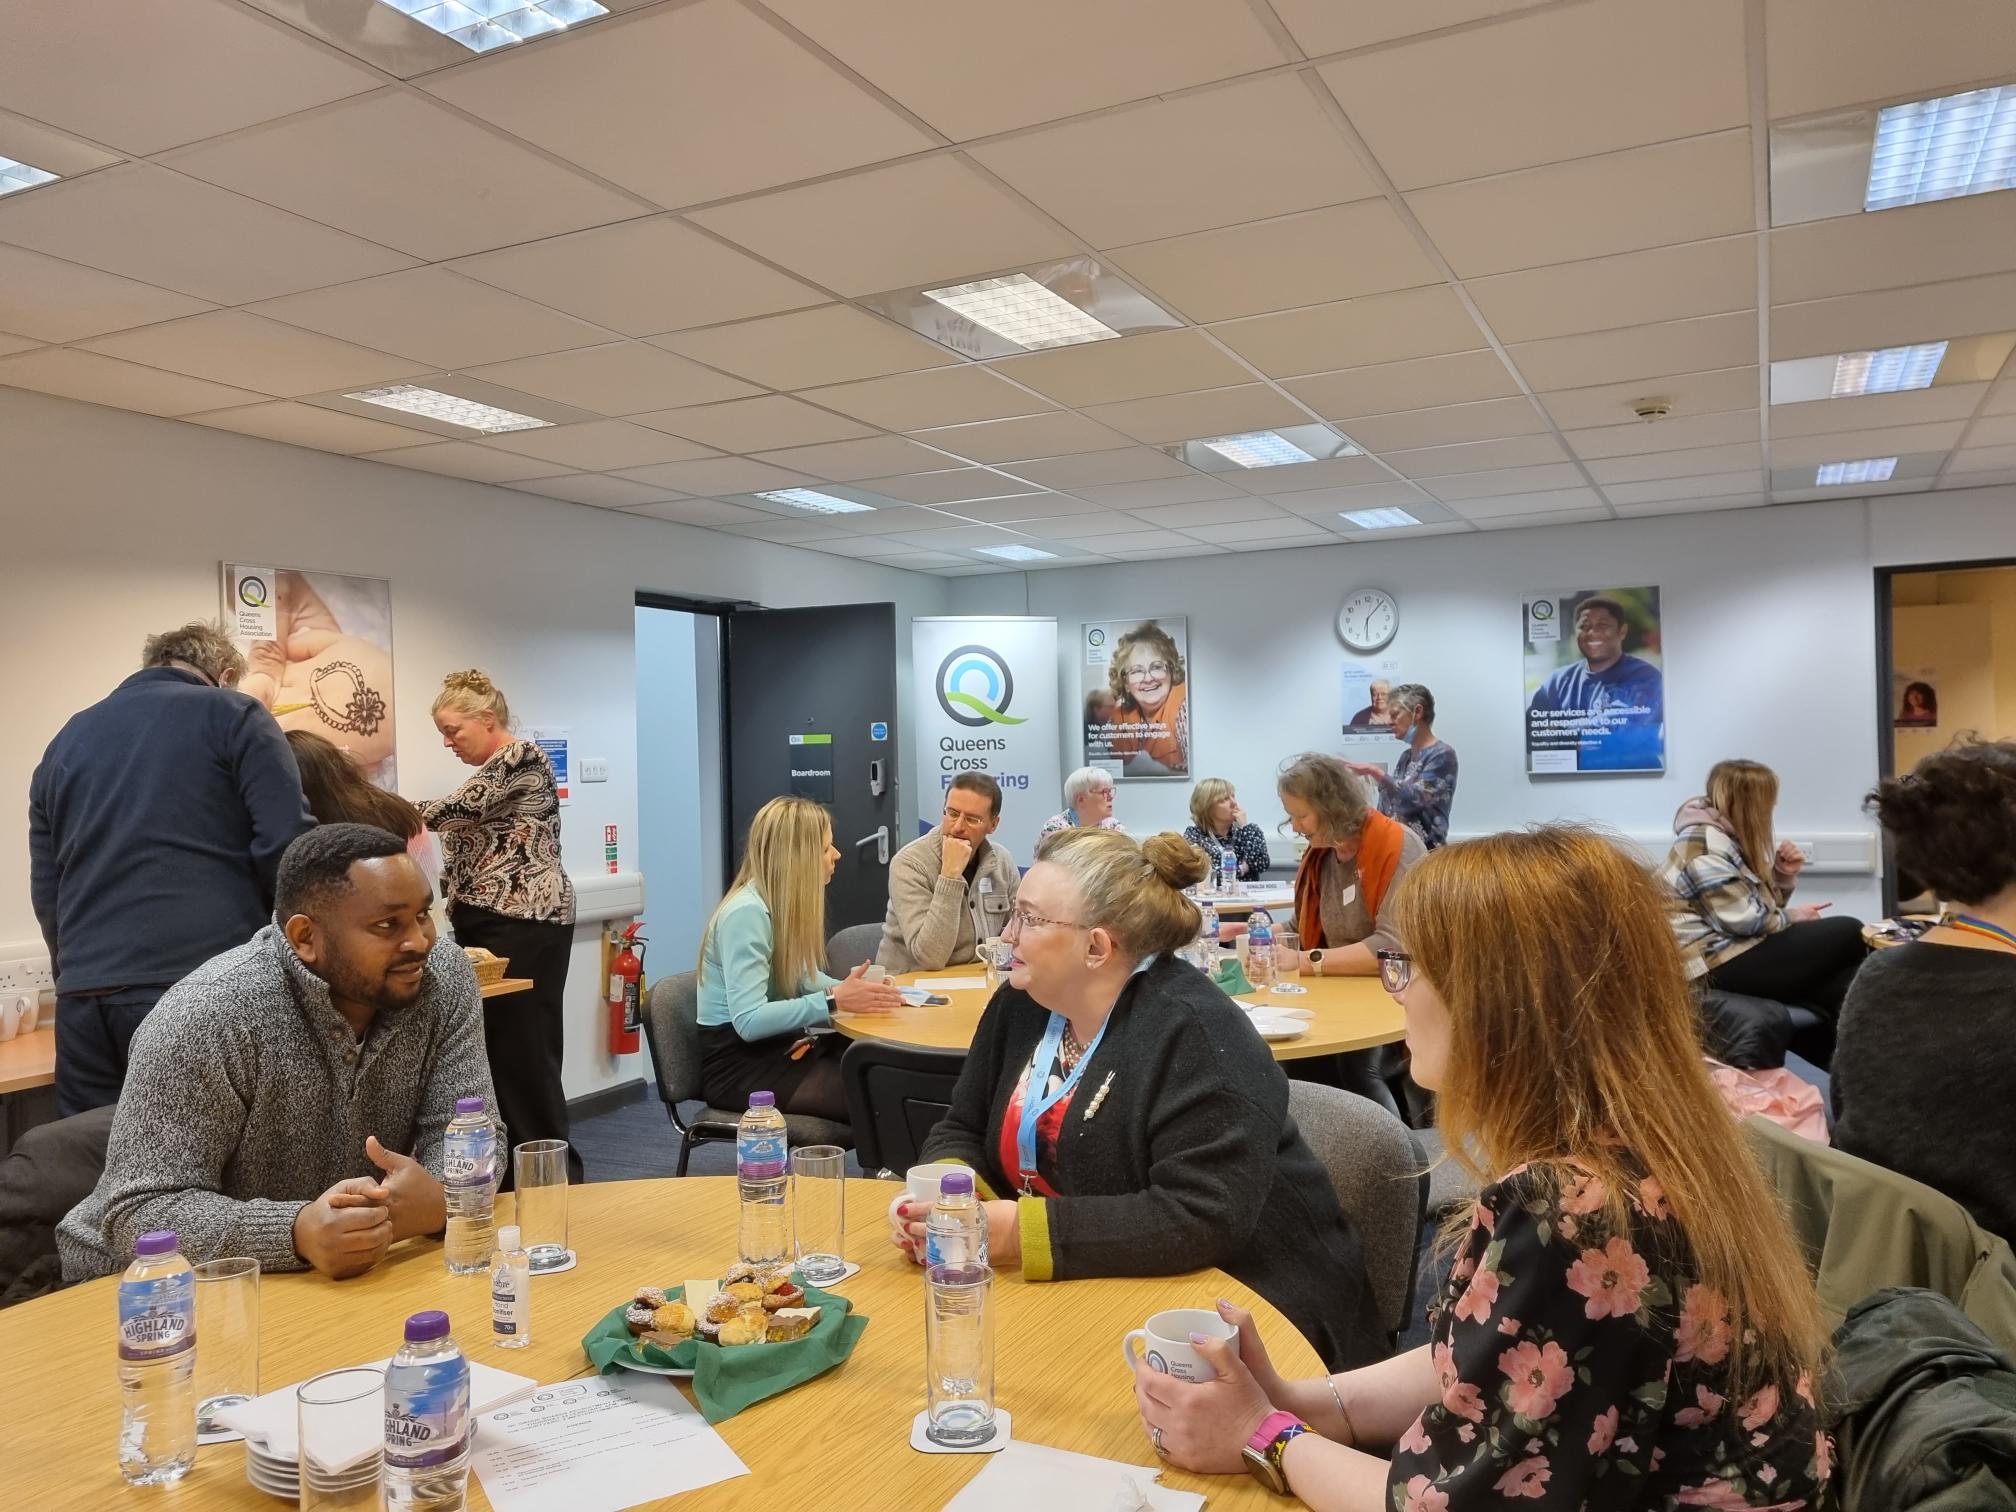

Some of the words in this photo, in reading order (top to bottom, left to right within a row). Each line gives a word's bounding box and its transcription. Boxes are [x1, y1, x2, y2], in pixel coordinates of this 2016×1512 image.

[1531, 709, 1548, 718] Our
[1550, 708, 1586, 717] services
[1587, 708, 1602, 716] are
[1603, 705, 1651, 715] accessible
[1101, 723, 1117, 731] offer
[1119, 722, 1148, 730] effective
[1531, 718, 1548, 727] and
[1550, 717, 1599, 727] responsive
[1600, 717, 1610, 725] to
[1612, 717, 1628, 725] our
[1099, 731, 1134, 739] customers
[1144, 731, 1170, 739] engage
[1531, 728, 1580, 737] customers'
[1581, 726, 1611, 735] needs.
[940, 736, 1006, 751] Queens
[940, 755, 988, 770] Cross
[791, 769, 831, 777] Boardroom
[941, 772, 1029, 790] Fring
[123, 1319, 185, 1338] HIGHLAND
[136, 1331, 170, 1342] SPRING
[1170, 1360, 1192, 1368] Queens
[1171, 1373, 1195, 1381] Housing
